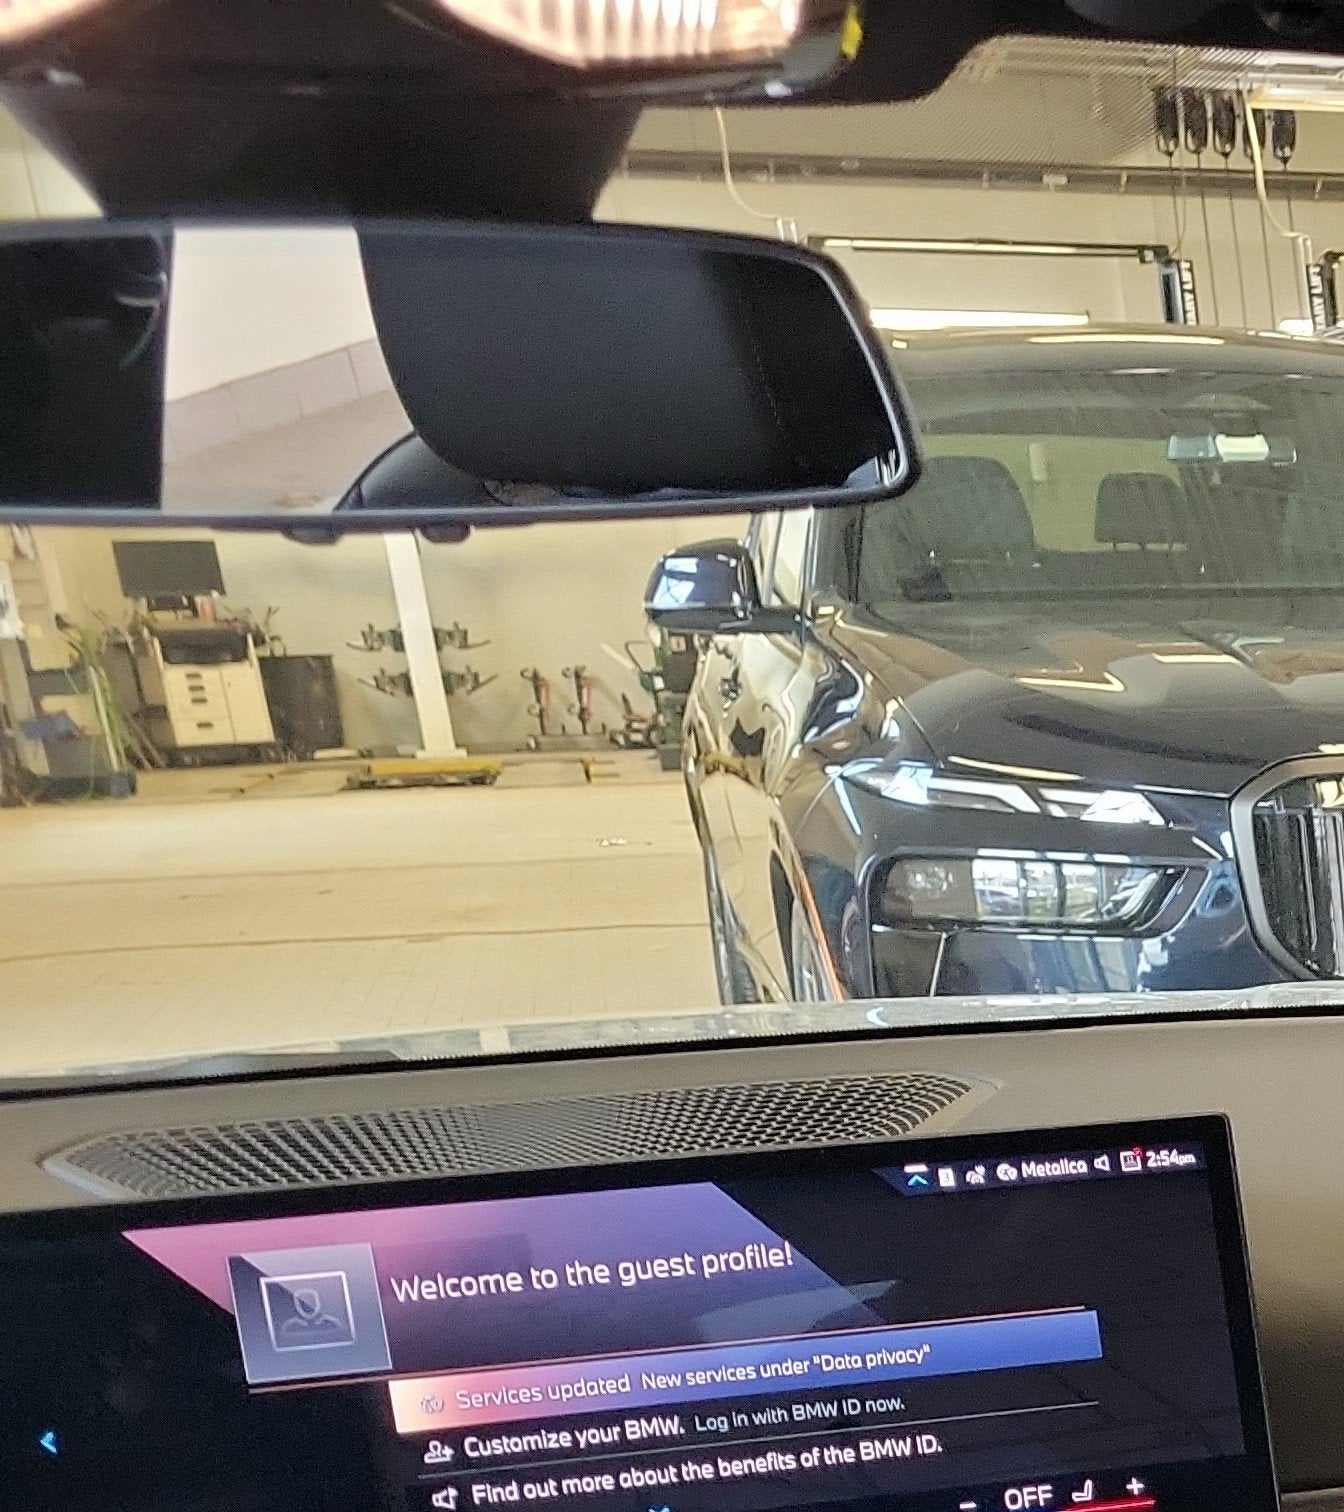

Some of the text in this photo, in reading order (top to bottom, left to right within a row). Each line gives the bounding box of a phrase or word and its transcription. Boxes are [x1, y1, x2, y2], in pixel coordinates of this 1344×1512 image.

[1308, 266, 1322, 294] LIFT
[1145, 1148, 1197, 1167] 2:54pm
[390, 1240, 794, 1302] Welcome to the guest profile!
[456, 1344, 931, 1410] Services updated New services under "Data privacy"
[464, 1396, 906, 1458] Customize your BMW. Log in with BMW ID now.
[472, 1434, 943, 1505] Find out more about the benefits of the BMW ID.
[1004, 1483, 1053, 1510] OFF
